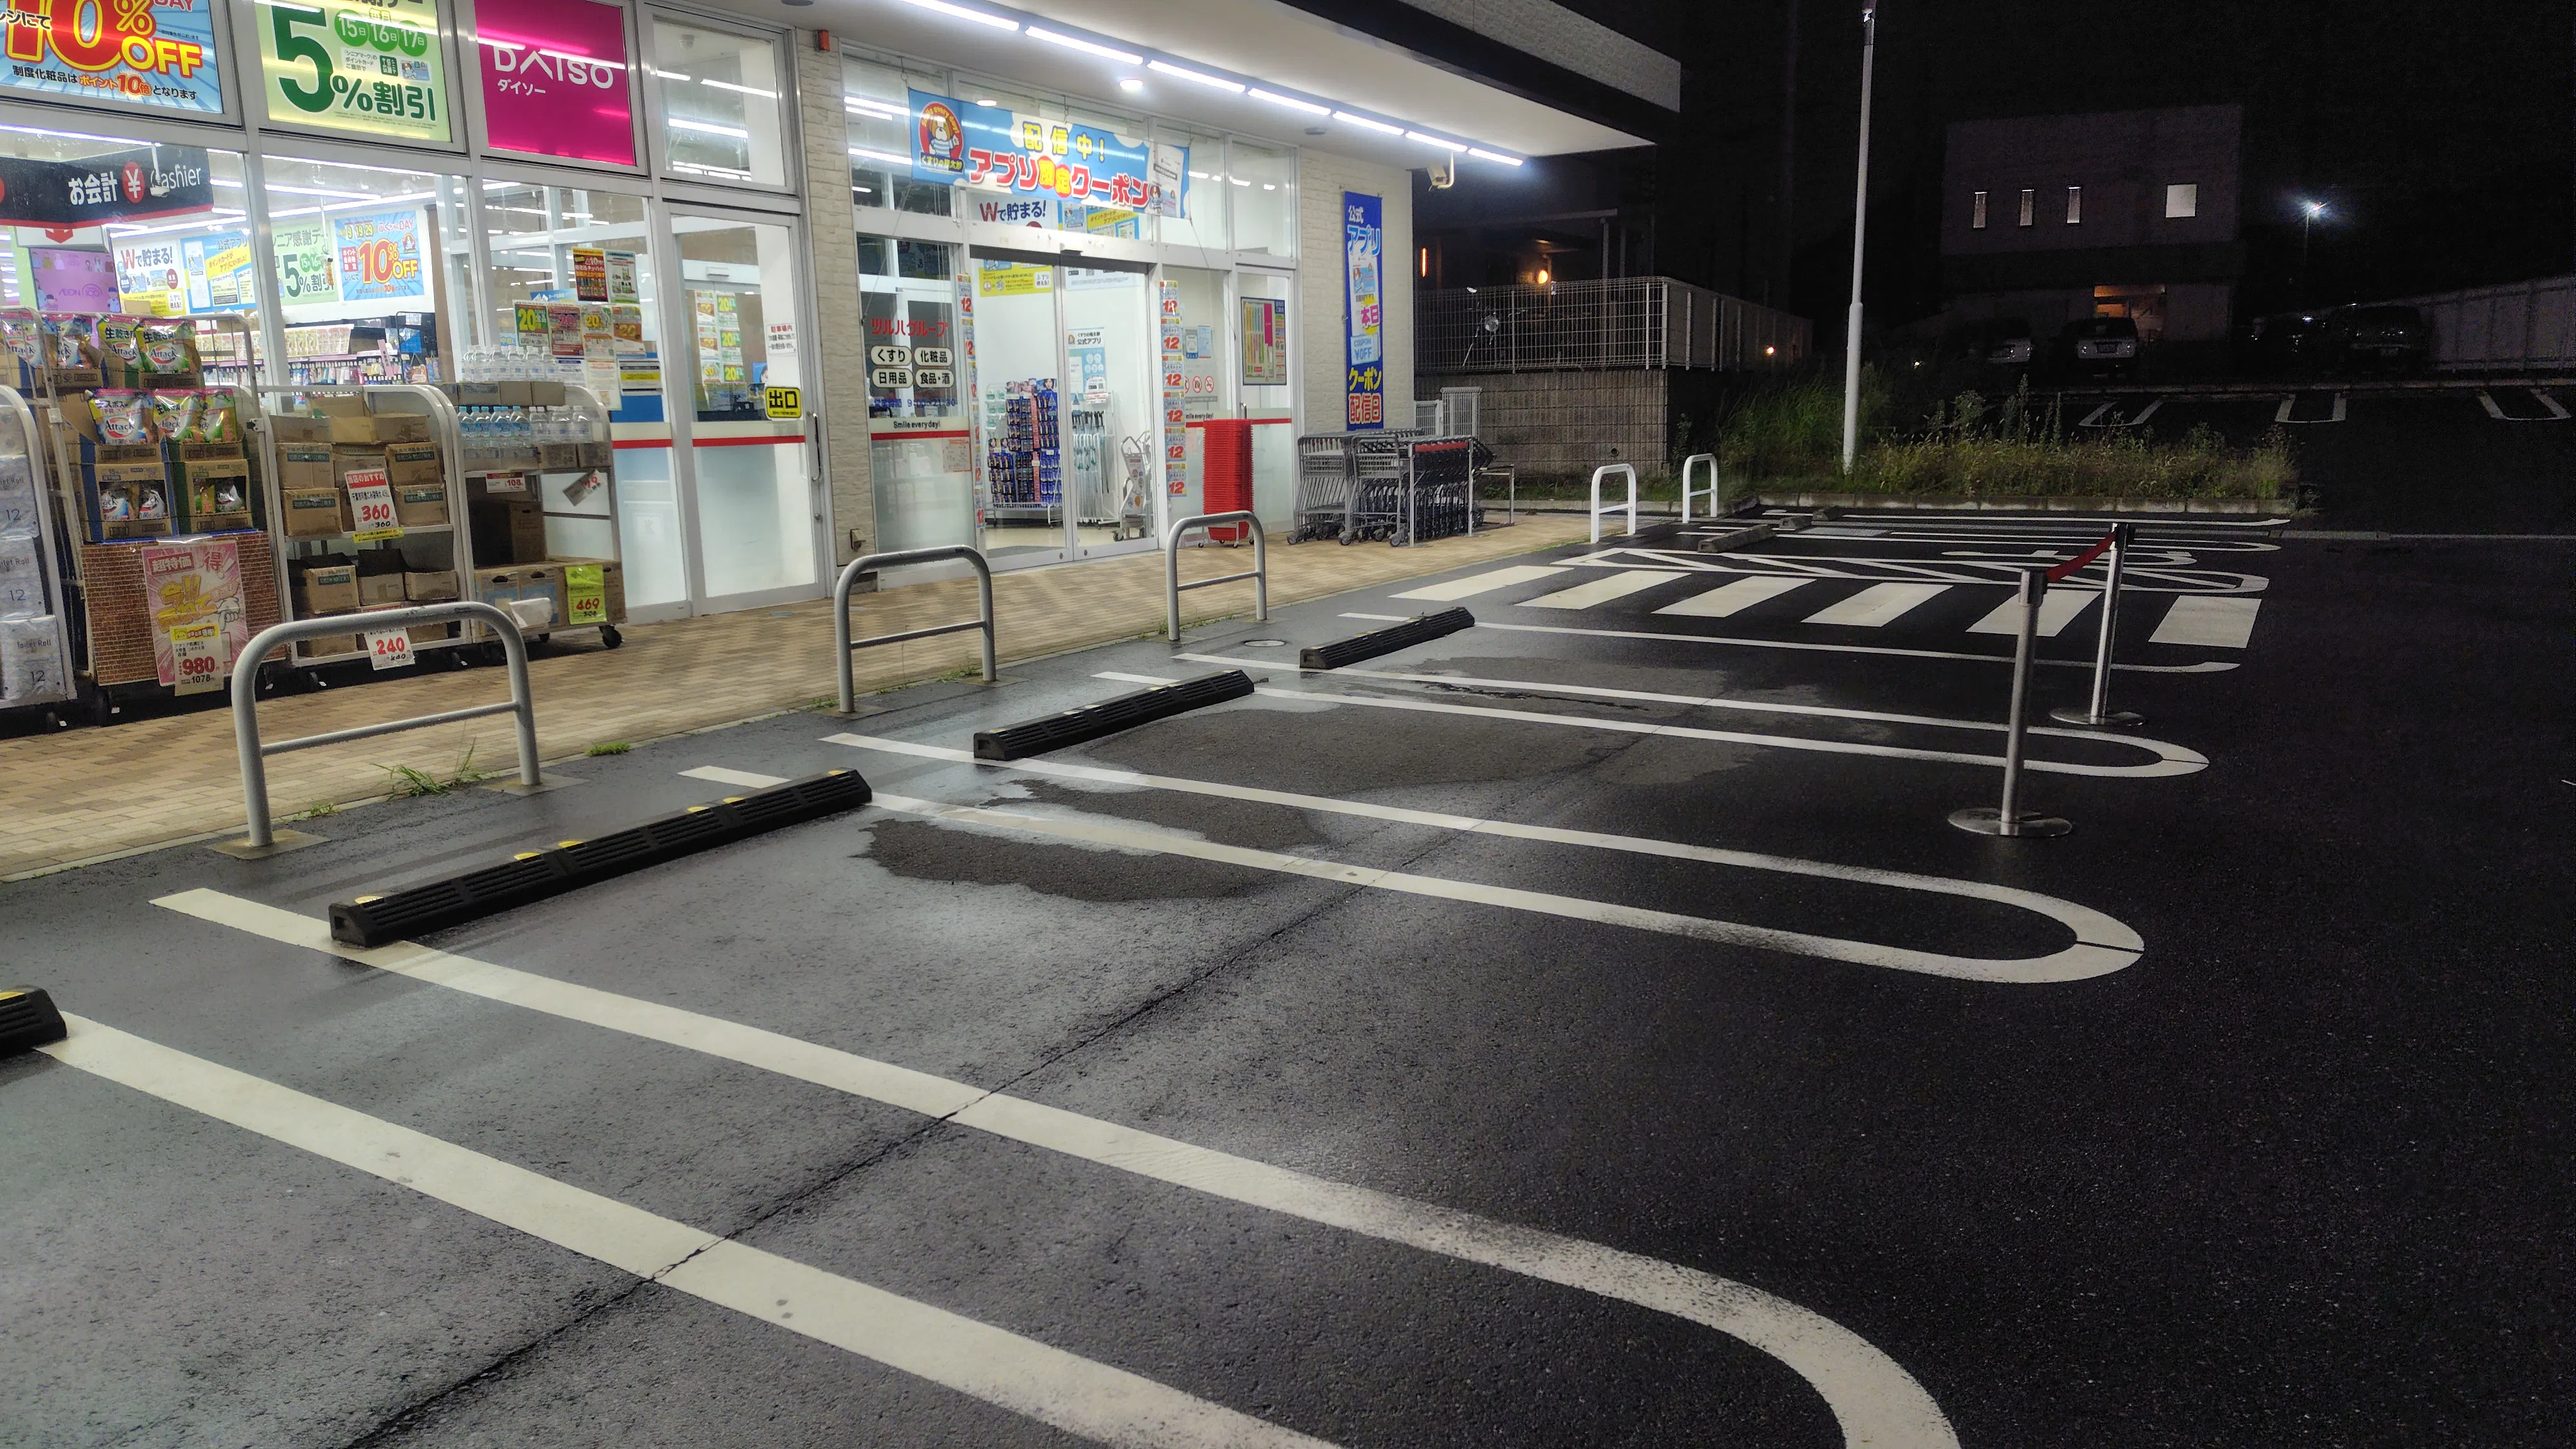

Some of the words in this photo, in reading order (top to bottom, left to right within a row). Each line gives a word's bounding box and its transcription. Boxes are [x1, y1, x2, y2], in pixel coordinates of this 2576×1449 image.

[121, 36, 203, 78] OFF
[494, 45, 614, 89] DAISO
[497, 79, 546, 96] ダイソー
[1023, 121, 1105, 162] 配信中!
[68, 171, 118, 205] お会計
[979, 199, 1046, 222] Wで貯まる!
[1348, 205, 1364, 223] 公式
[273, 228, 328, 247] ニア感謝デ
[1348, 225, 1380, 255] アプリ
[392, 260, 418, 279] OFF
[1361, 305, 1379, 325] 本日
[871, 318, 948, 338] ツルハグループ
[151, 347, 178, 358] Attack
[877, 348, 906, 363] くすり
[920, 350, 948, 363] 化粧品
[879, 372, 907, 384] 日用品
[1349, 366, 1382, 391] クーポン
[769, 390, 798, 409] 出口
[1350, 394, 1380, 422] 配信日
[106, 419, 135, 431] Attack
[507, 479, 521, 487] 108
[6, 509, 21, 521] 12
[362, 503, 390, 522] 360
[9, 589, 26, 601] 12
[375, 636, 405, 655] 240
[182, 656, 215, 676] 980
[31, 670, 46, 682] 12
[191, 674, 211, 684] 1078
